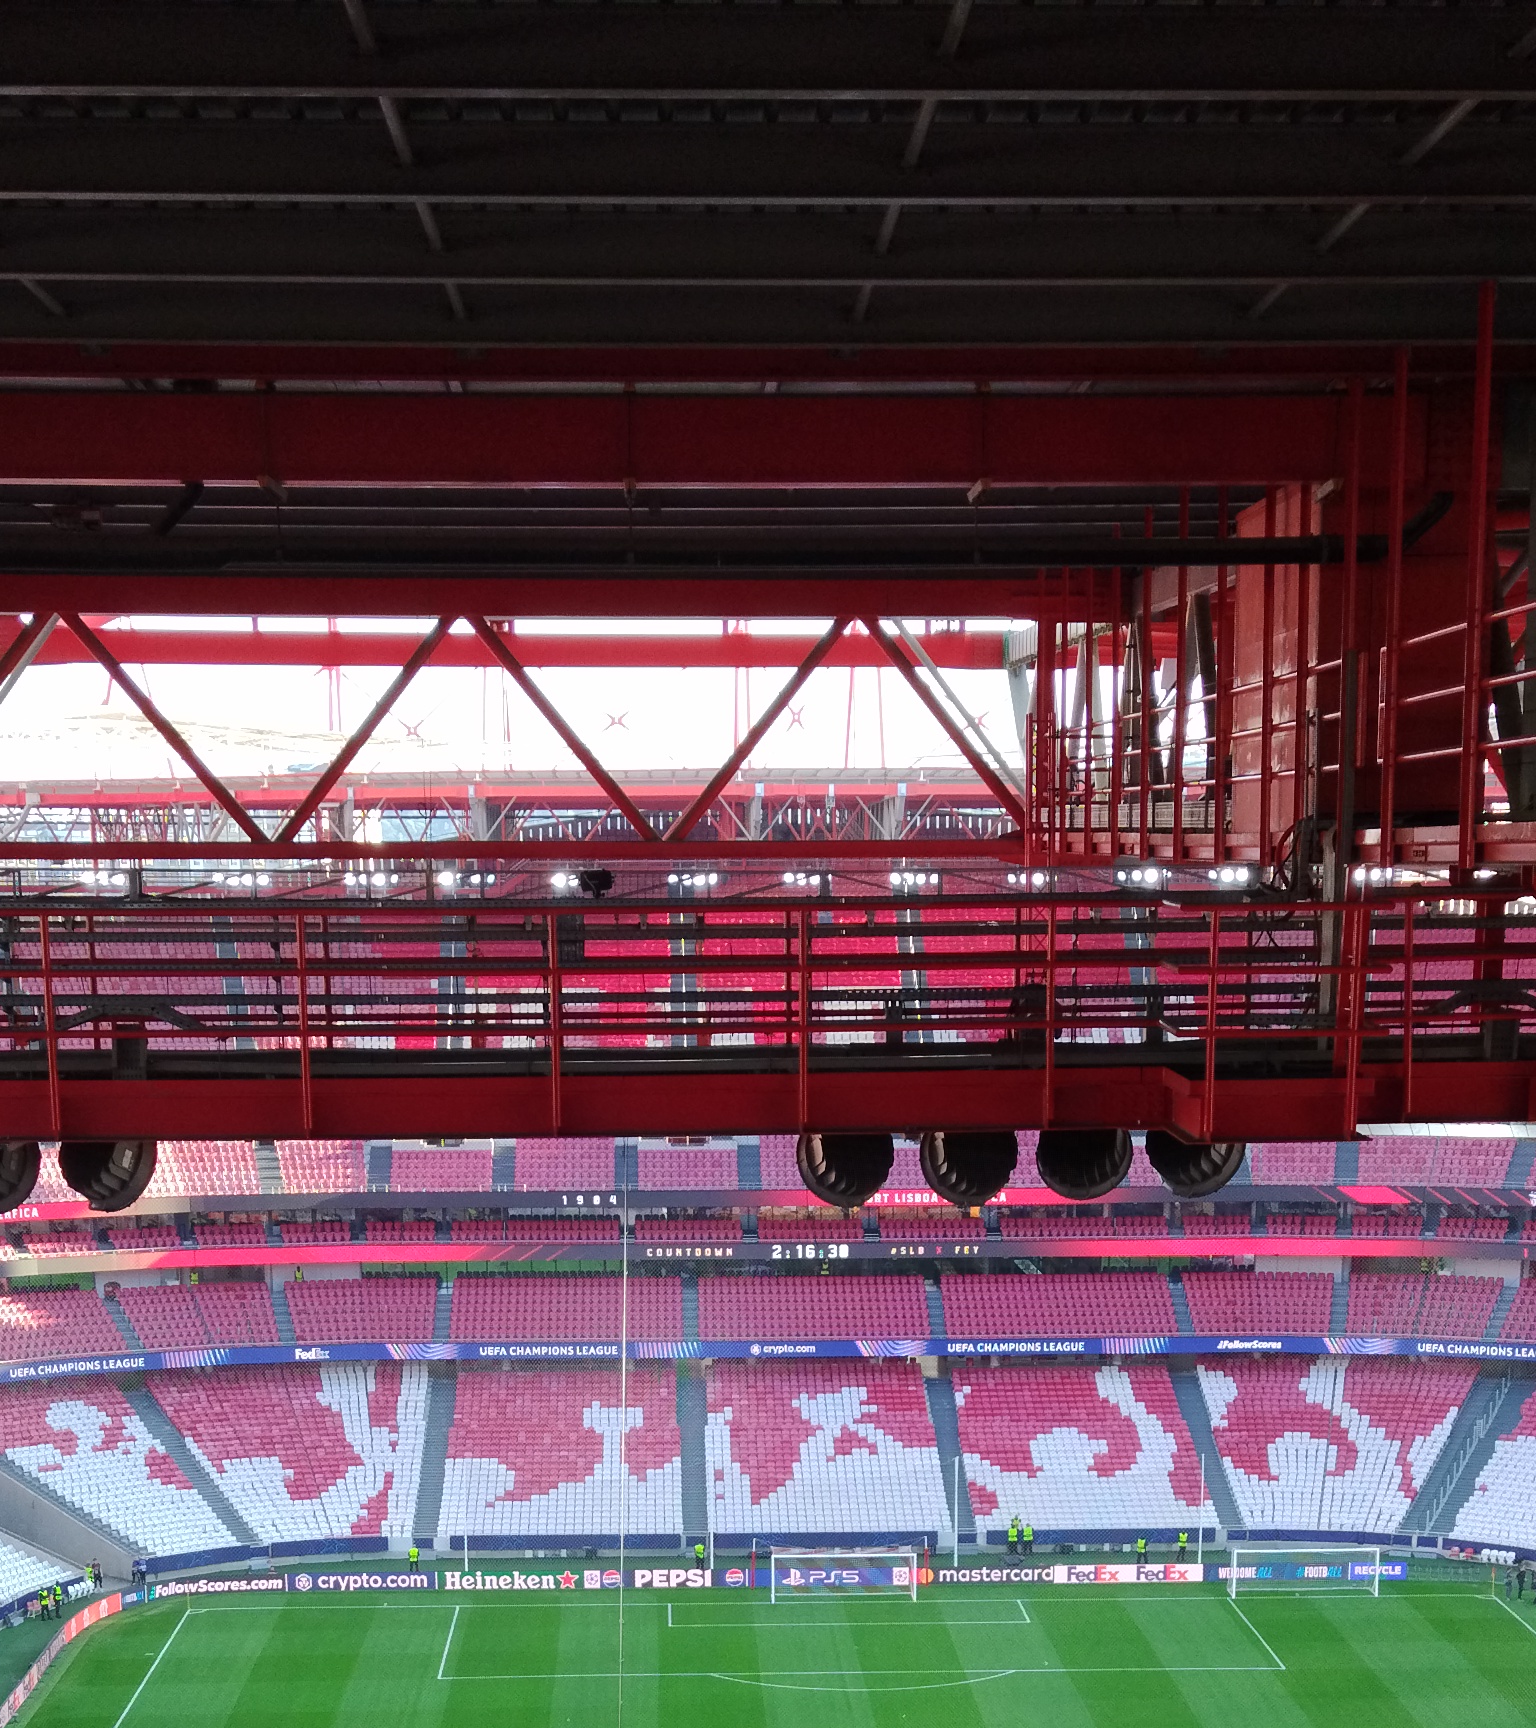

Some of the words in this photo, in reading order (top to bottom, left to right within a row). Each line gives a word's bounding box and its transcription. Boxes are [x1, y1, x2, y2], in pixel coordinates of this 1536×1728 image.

[646, 1247, 734, 1258] COUNTDOWN
[479, 1345, 508, 1356] UEFA
[509, 1345, 574, 1356] CHAMPIONS
[576, 1345, 619, 1355] LEAGUE
[763, 1343, 816, 1355] crypto.com
[947, 1342, 976, 1353] UEFA
[977, 1342, 1042, 1352] CHAMPIONS
[1044, 1341, 1085, 1351] LEAGUE
[1417, 1342, 1446, 1354] UEFA
[1447, 1344, 1513, 1357] CHAMPIONS
[9, 1367, 36, 1378] UEFA
[37, 1360, 102, 1376] CHAMPIONS
[103, 1357, 145, 1370] LEAGUE
[444, 1570, 556, 1590] Heineken
[634, 1568, 712, 1588] PEPSI
[809, 1569, 860, 1584] PS5
[939, 1566, 1054, 1582] mastercard
[1066, 1564, 1119, 1582] FedEx
[1136, 1563, 1189, 1582] FedEx
[154, 1577, 284, 1599] FollowScores.com
[317, 1572, 428, 1591] crypto.com
